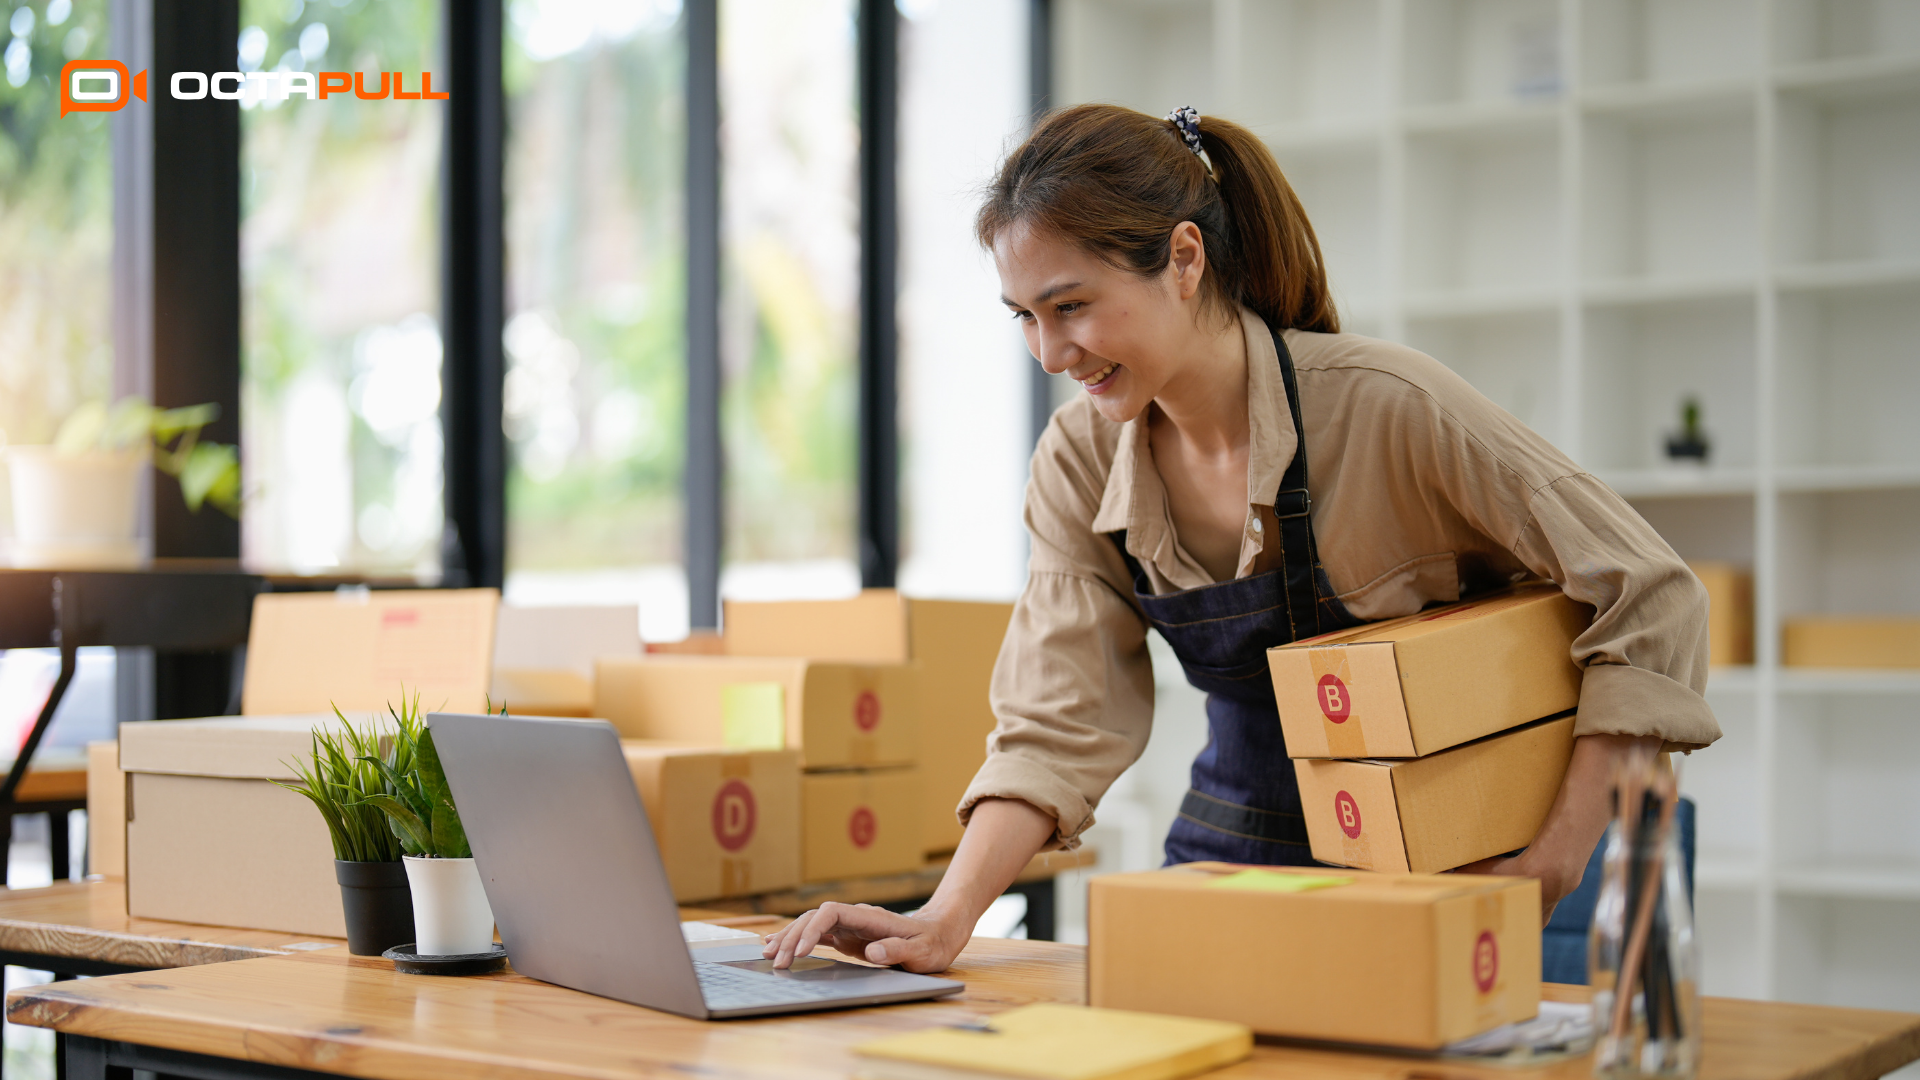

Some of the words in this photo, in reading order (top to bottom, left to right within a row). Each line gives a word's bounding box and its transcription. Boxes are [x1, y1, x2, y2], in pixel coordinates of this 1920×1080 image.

[1324, 684, 1343, 713] B
[721, 795, 748, 837] D
[1340, 800, 1356, 828] B
[1477, 940, 1495, 983] B
